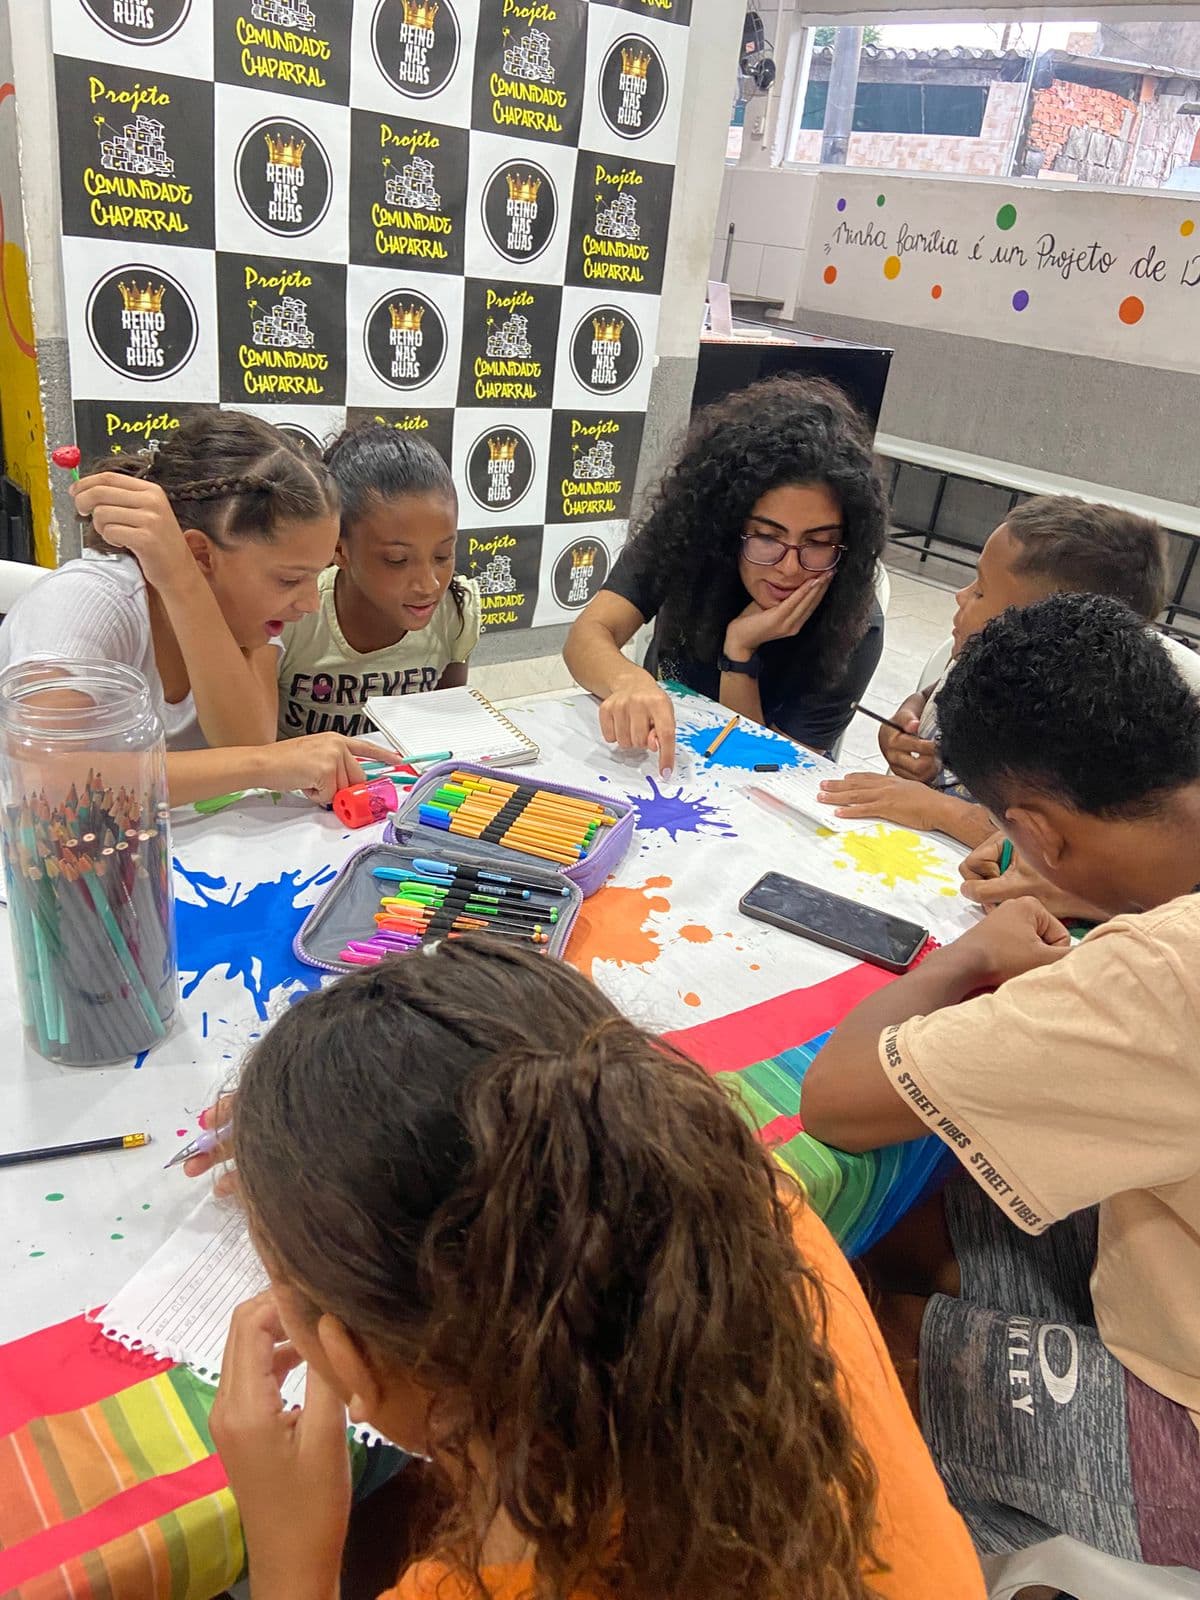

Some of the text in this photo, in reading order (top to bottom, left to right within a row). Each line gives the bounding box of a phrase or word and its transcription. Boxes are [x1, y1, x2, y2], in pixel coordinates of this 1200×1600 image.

[113, 1, 154, 29] RUAS
[503, 0, 557, 26] Projeto
[400, 23, 434, 48] REINO
[405, 45, 426, 65] NAS
[241, 48, 326, 88] CHAPARRAL
[399, 63, 429, 85] RUAS
[89, 77, 170, 112] Projeto
[619, 73, 647, 95] REINO
[623, 93, 640, 110] NAS
[492, 102, 562, 132] CHAPARRAL
[618, 107, 642, 127] RUAS
[380, 124, 440, 155] Projeto
[266, 162, 304, 187] REINO
[595, 165, 643, 192] Projeto
[274, 183, 298, 203] NAS
[90, 200, 188, 232] CHAPARRAL
[268, 200, 302, 223] RUAS
[506, 200, 537, 219] REINO
[512, 216, 532, 235] NAS
[375, 231, 448, 259] CHAPARRAL
[507, 233, 533, 251] RUAS
[968, 235, 984, 260] é
[1036, 233, 1118, 279] Projeto
[1130, 246, 1167, 282] de
[584, 257, 644, 282] CHAPARRAL
[245, 266, 312, 295] Projeto
[487, 289, 534, 313] Projeto
[121, 310, 165, 331] REINO
[131, 330, 158, 349] NAS
[389, 329, 422, 347] REINO
[592, 340, 621, 356] REINO
[126, 347, 164, 367] RUAS
[396, 345, 416, 362] NAS
[596, 354, 614, 369] NAS
[391, 360, 420, 378] RUAS
[591, 367, 617, 384] RUAS
[244, 371, 323, 394] CHAPARRAL
[475, 379, 536, 400] CHAPARRAL
[106, 413, 180, 439] Projeto
[572, 420, 619, 438] Projeto
[488, 459, 514, 474] REINO
[491, 473, 509, 487] NAS
[488, 486, 511, 501] RUAS
[563, 498, 615, 516] CHAPARRAL
[469, 534, 516, 555] Projeto
[570, 566, 594, 579] REINO
[572, 577, 587, 590] NAS
[568, 588, 589, 602] RUAS
[480, 611, 517, 625] PARRAL
[290, 667, 437, 705] FOREVER
[285, 701, 378, 737] SUM
[898, 1072, 939, 1117] STREET
[937, 1117, 972, 1149] VIBES
[970, 1152, 1012, 1196] STREET
[1009, 1195, 1041, 1226] VIBES
